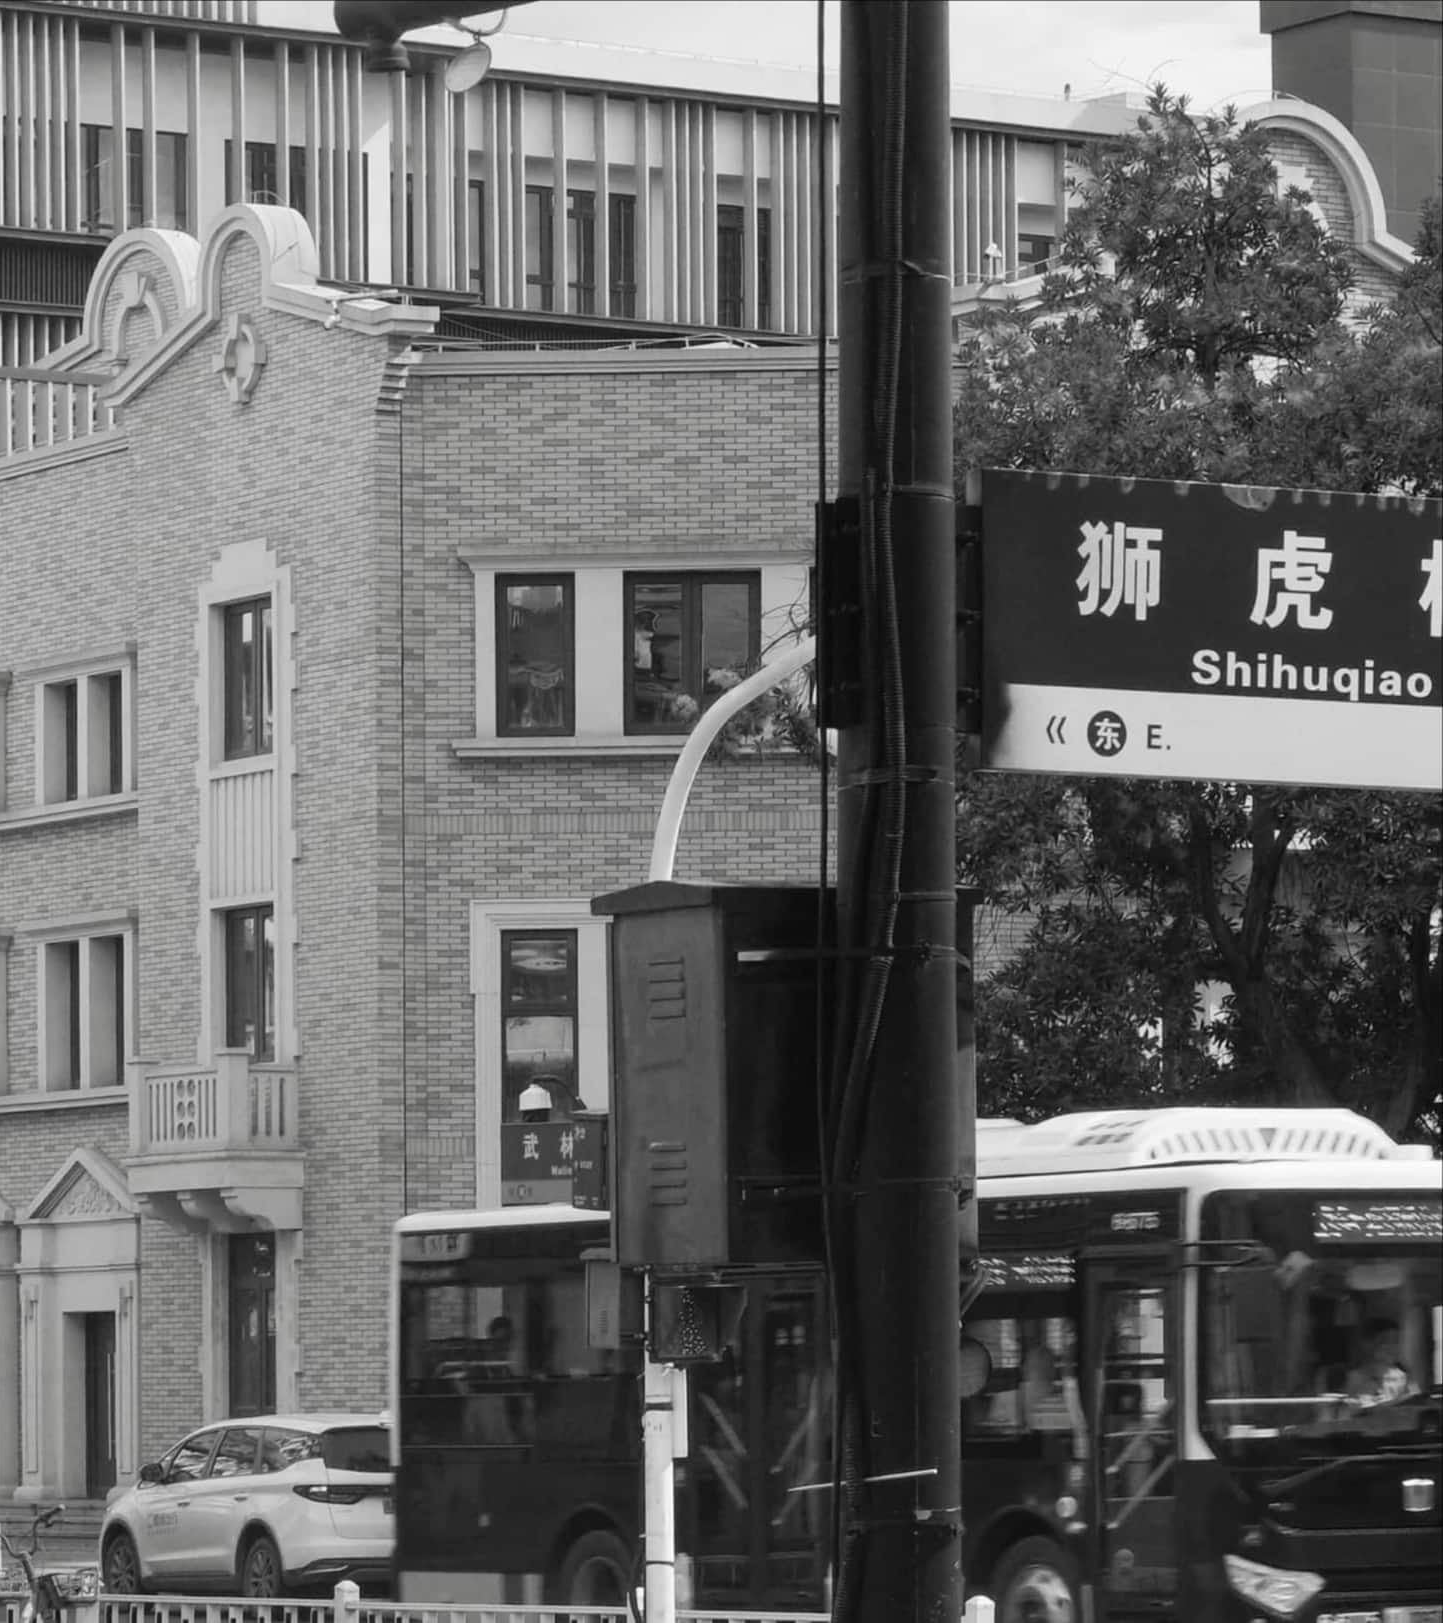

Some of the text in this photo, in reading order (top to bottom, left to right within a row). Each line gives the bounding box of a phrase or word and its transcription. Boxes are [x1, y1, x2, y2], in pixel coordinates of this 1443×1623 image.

[1076, 520, 1443, 638] 狮虎
[1191, 648, 1433, 702] Shihuqiao
[1094, 719, 1172, 750] 东 E.
